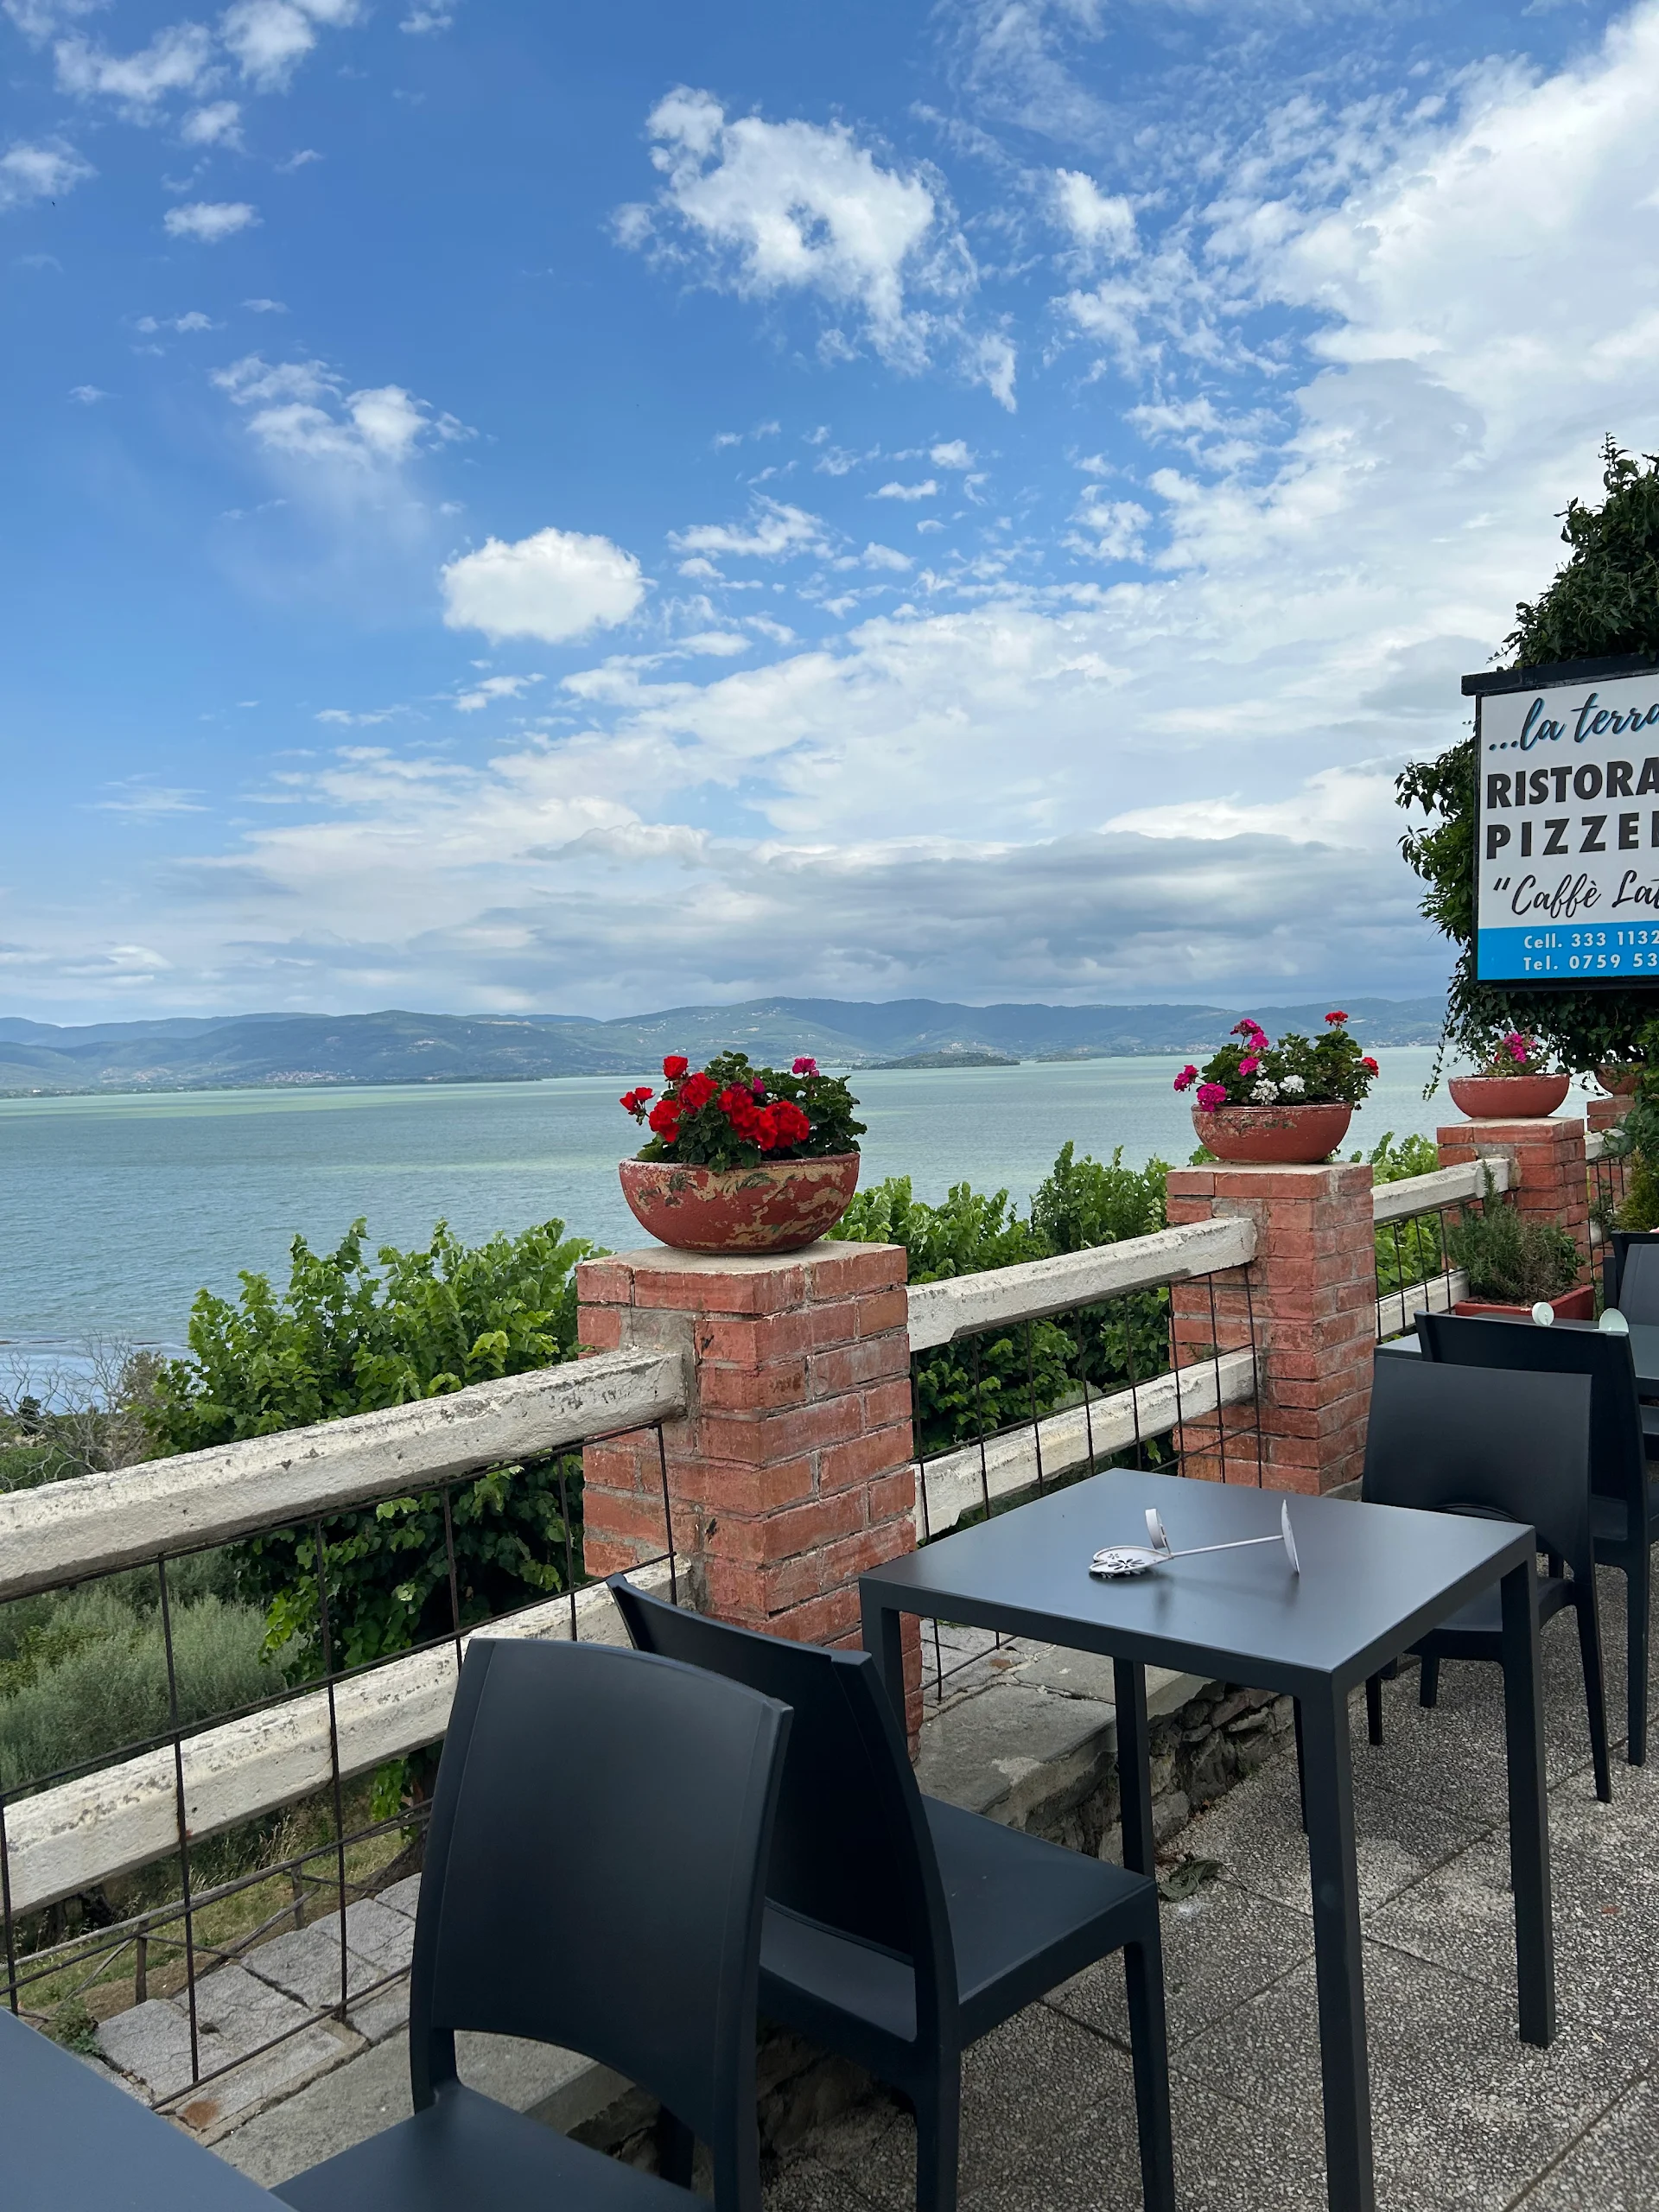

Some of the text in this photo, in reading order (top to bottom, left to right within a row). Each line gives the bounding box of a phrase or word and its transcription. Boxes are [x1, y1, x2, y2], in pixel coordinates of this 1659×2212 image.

[1487, 757, 1659, 809] RISTORA
[1524, 930, 1659, 949] Cell. 333 1132
[1523, 955, 1559, 971] Tel.
[1569, 954, 1621, 969] 0759
